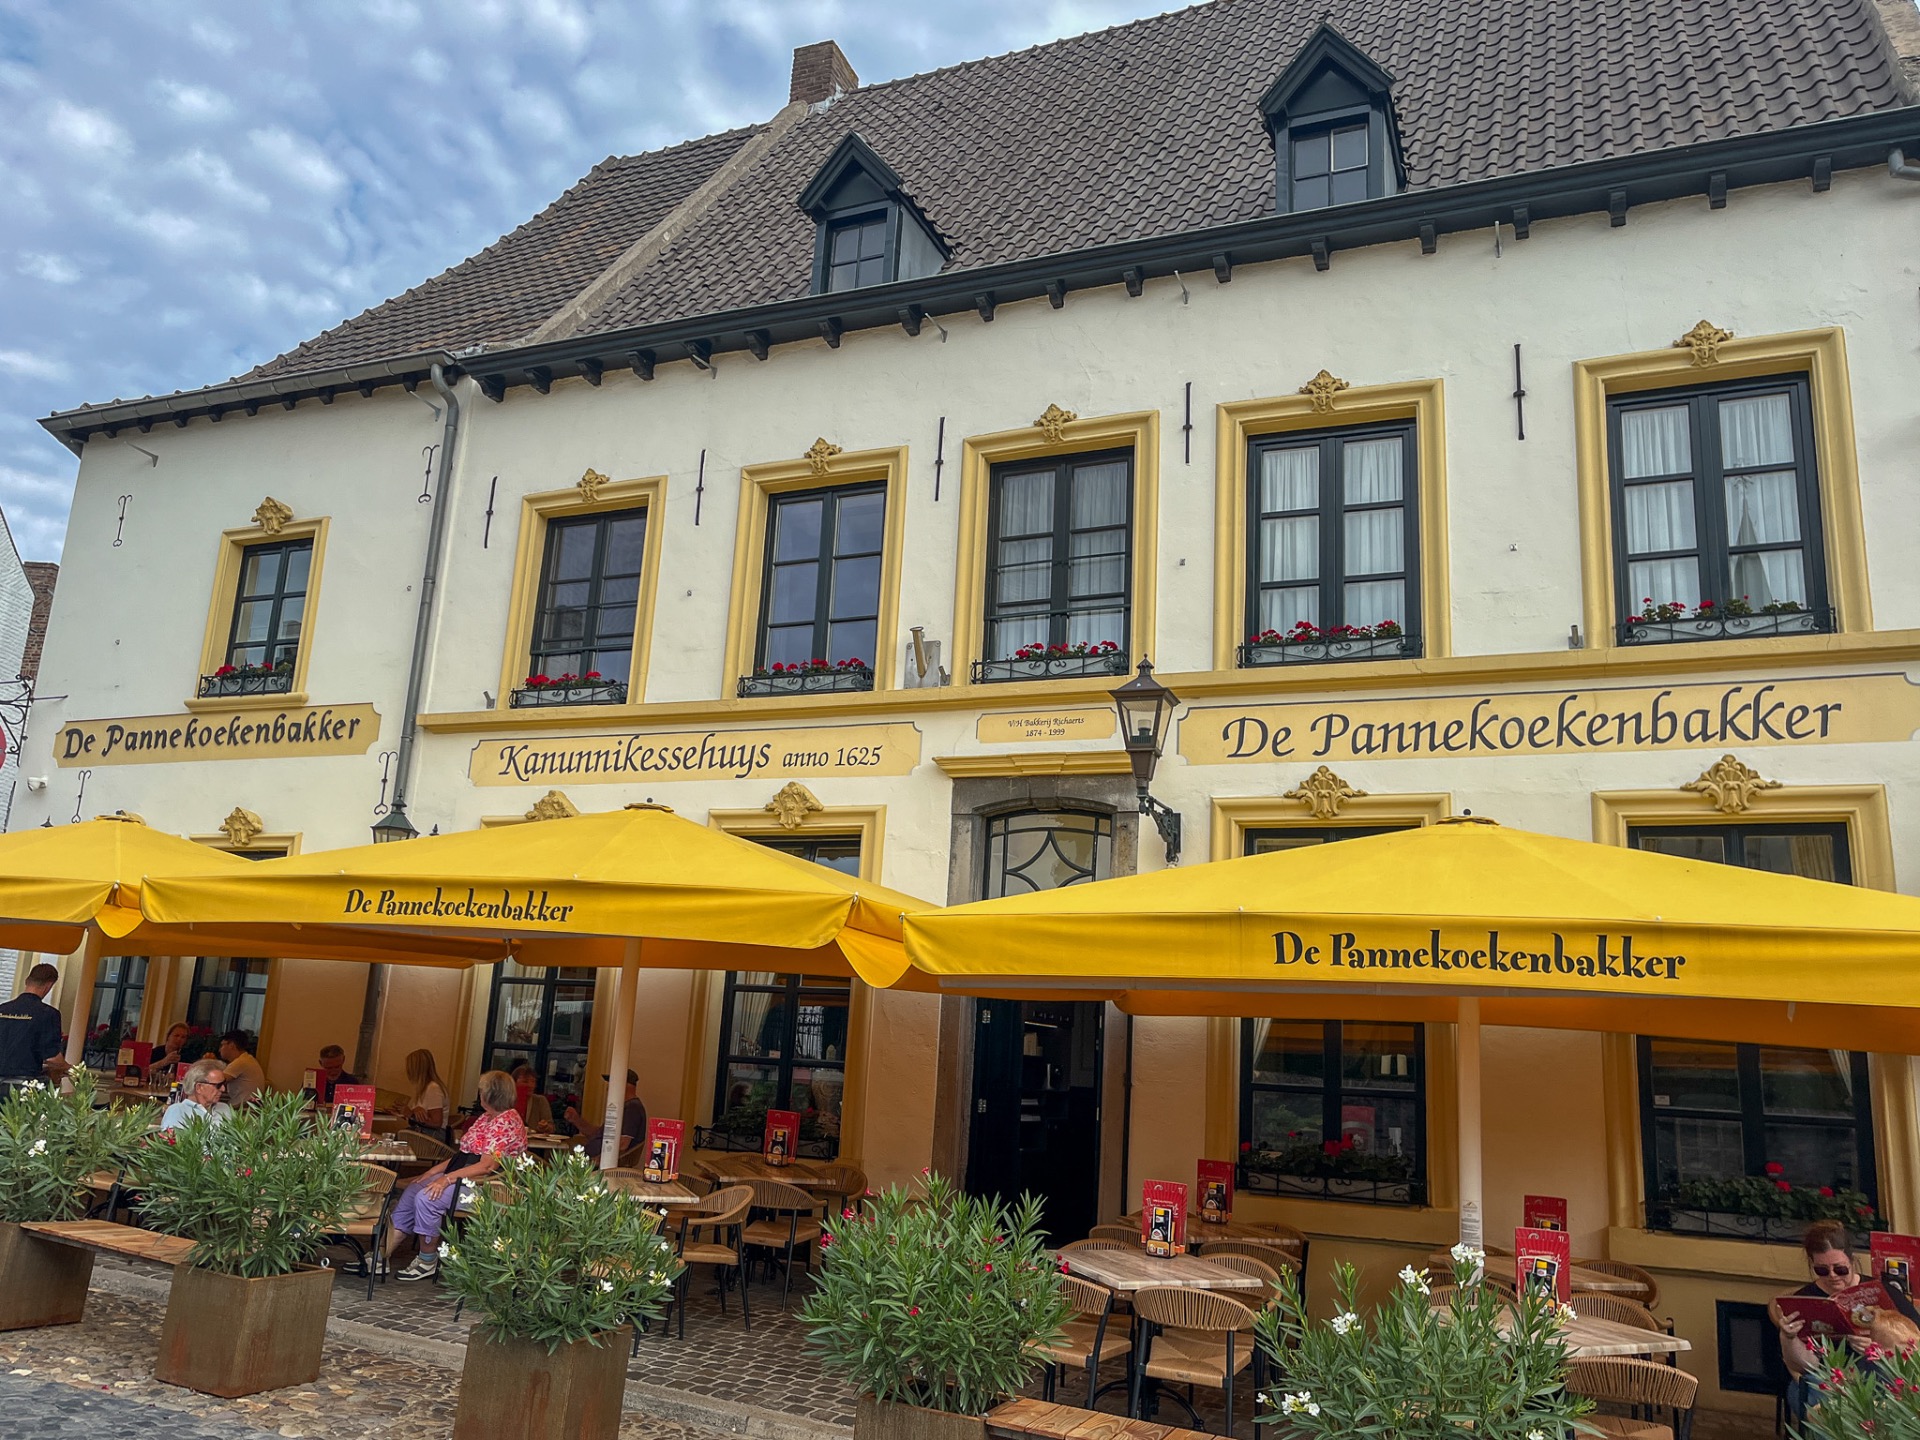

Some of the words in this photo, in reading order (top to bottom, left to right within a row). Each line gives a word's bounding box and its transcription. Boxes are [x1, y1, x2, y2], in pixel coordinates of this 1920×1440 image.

[63, 727, 96, 759] De
[101, 709, 361, 757] Pannekoekenbakker
[1024, 717, 1052, 729] Bakkerij
[1026, 729, 1042, 737] 1874
[1049, 728, 1066, 736] 1999
[1222, 715, 1295, 759] De
[1310, 685, 1842, 757] Pannekoekenbakker
[498, 733, 772, 782] Kanunnikessehuys
[782, 750, 829, 769] anno
[834, 744, 884, 768] 1625
[344, 888, 372, 914] De
[375, 886, 574, 923] Pannekoekenbakker
[1271, 931, 1320, 966] De
[1330, 929, 1687, 980] Pannekoekenbakker
